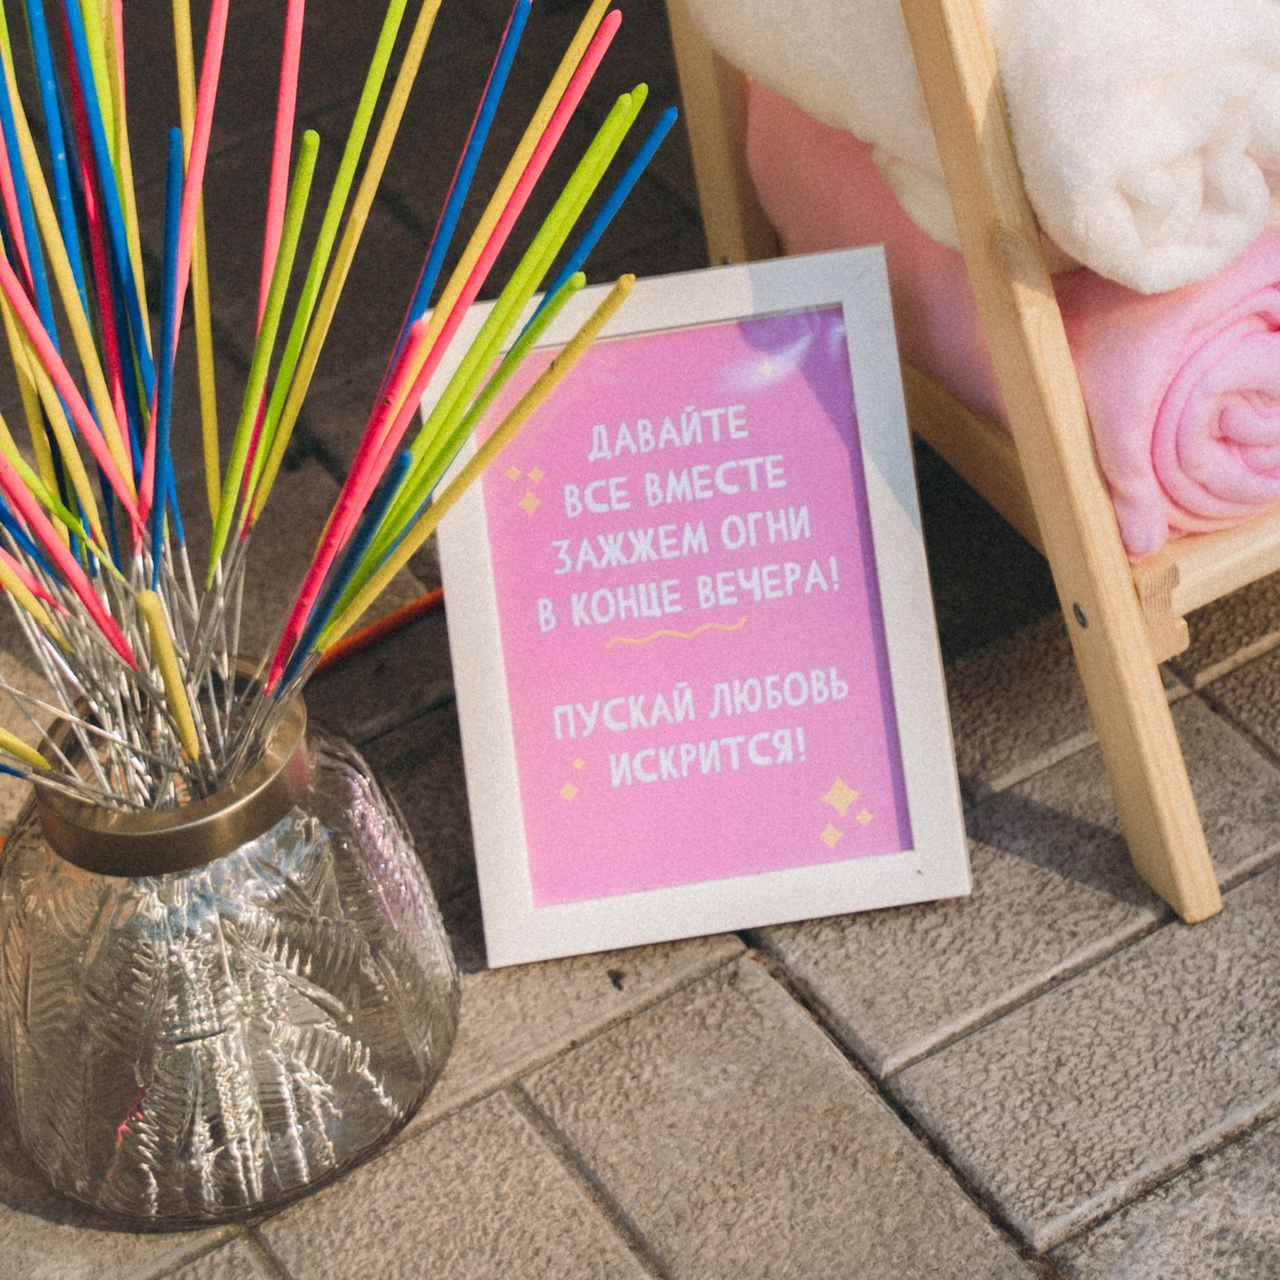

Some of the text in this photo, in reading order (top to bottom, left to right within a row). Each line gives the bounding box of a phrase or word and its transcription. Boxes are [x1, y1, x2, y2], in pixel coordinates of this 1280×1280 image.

[588, 404, 749, 462] ДАВАЙТЕ
[563, 454, 787, 519] ВСЕ ВМЕСТЕ
[552, 505, 811, 575] ЗАЖЖЕМ ОГНИ
[537, 555, 840, 632] В КОНЦЕ ВЕЧЕРА!
[553, 666, 849, 740] ПУСКАЙ ЛЮБОВЬ
[608, 725, 806, 788] ИСКРИТСЯ!
